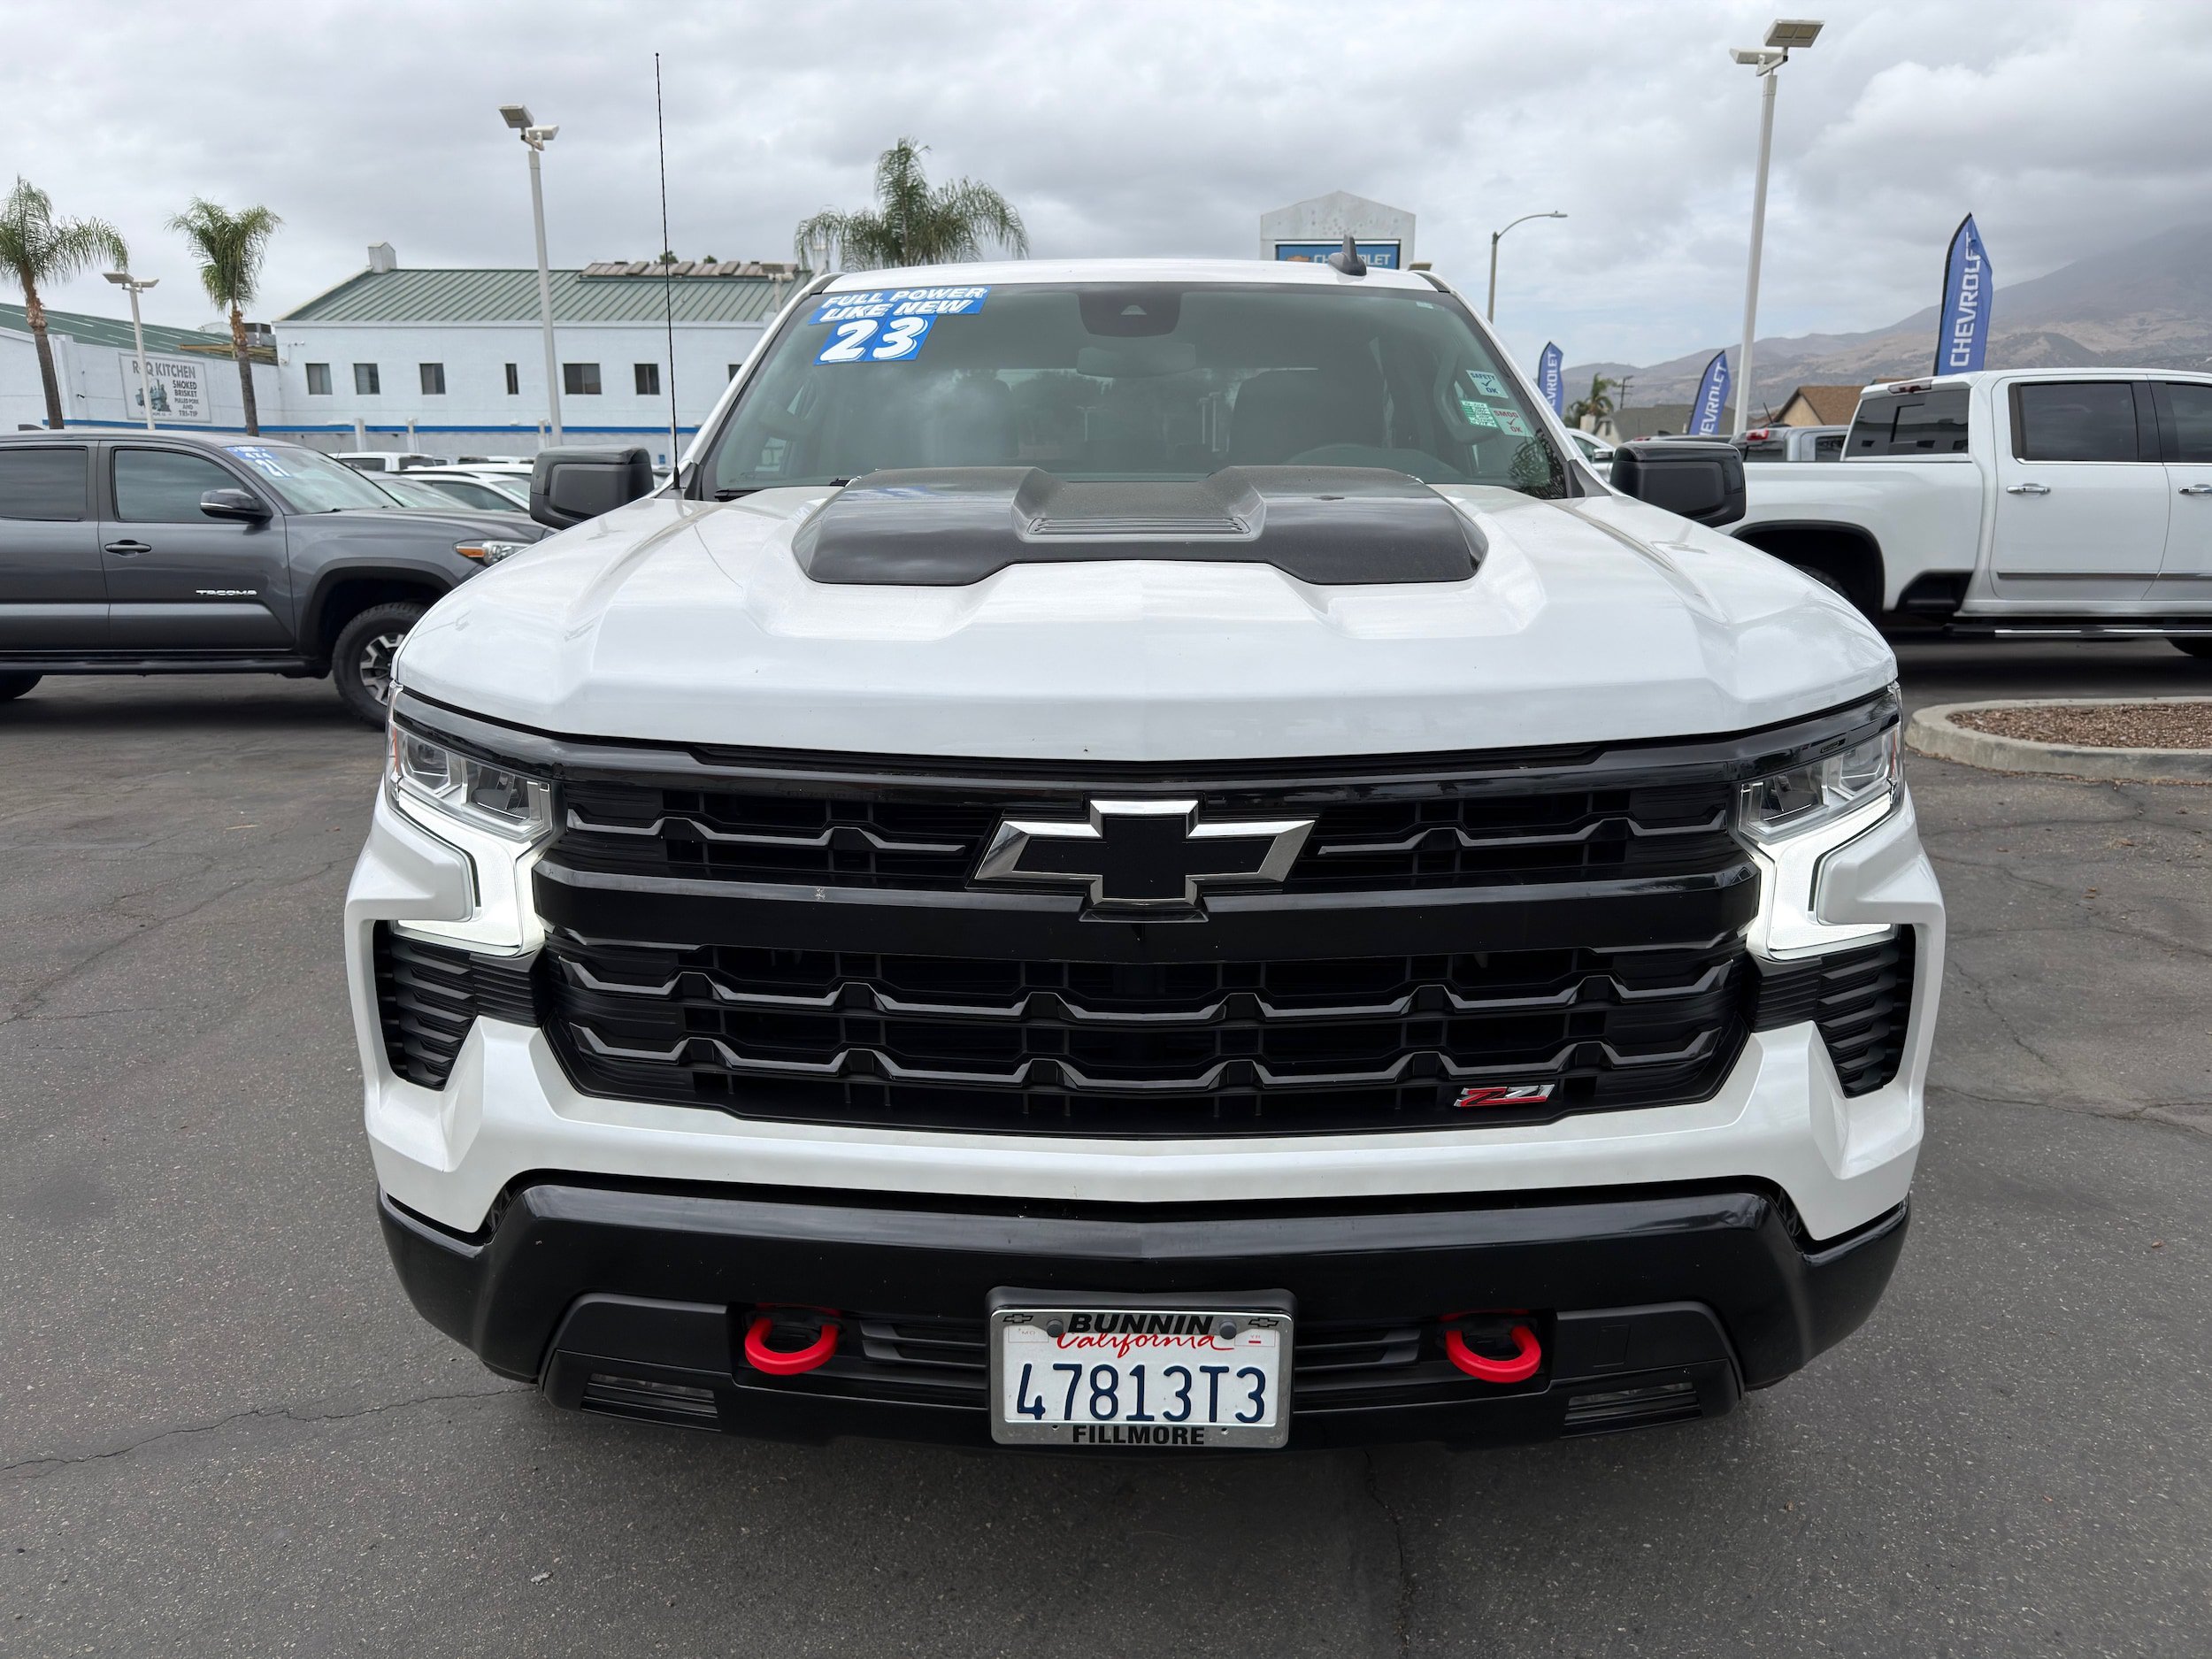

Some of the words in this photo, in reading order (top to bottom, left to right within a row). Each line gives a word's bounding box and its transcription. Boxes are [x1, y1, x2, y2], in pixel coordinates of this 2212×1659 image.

[1313, 254, 1391, 265] CHLET
[822, 292, 884, 309] FULL
[889, 288, 988, 303] POWER
[1949, 232, 1982, 367] CHEVROLET
[819, 303, 894, 322] LIKE
[892, 299, 974, 316] NEW
[819, 316, 929, 363] 23
[155, 362, 196, 379] KITCHEN
[1546, 350, 1558, 407] EVROLET
[173, 380, 197, 390] SMOKED
[1494, 410, 1519, 419] SMOG
[1453, 1084, 1555, 1108] Z71
[1067, 1313, 1214, 1335] BUNNIN
[1056, 1332, 1235, 1359] California
[1016, 1363, 1267, 1424] 47813T3
[1071, 1425, 1205, 1446] FILLMORE
